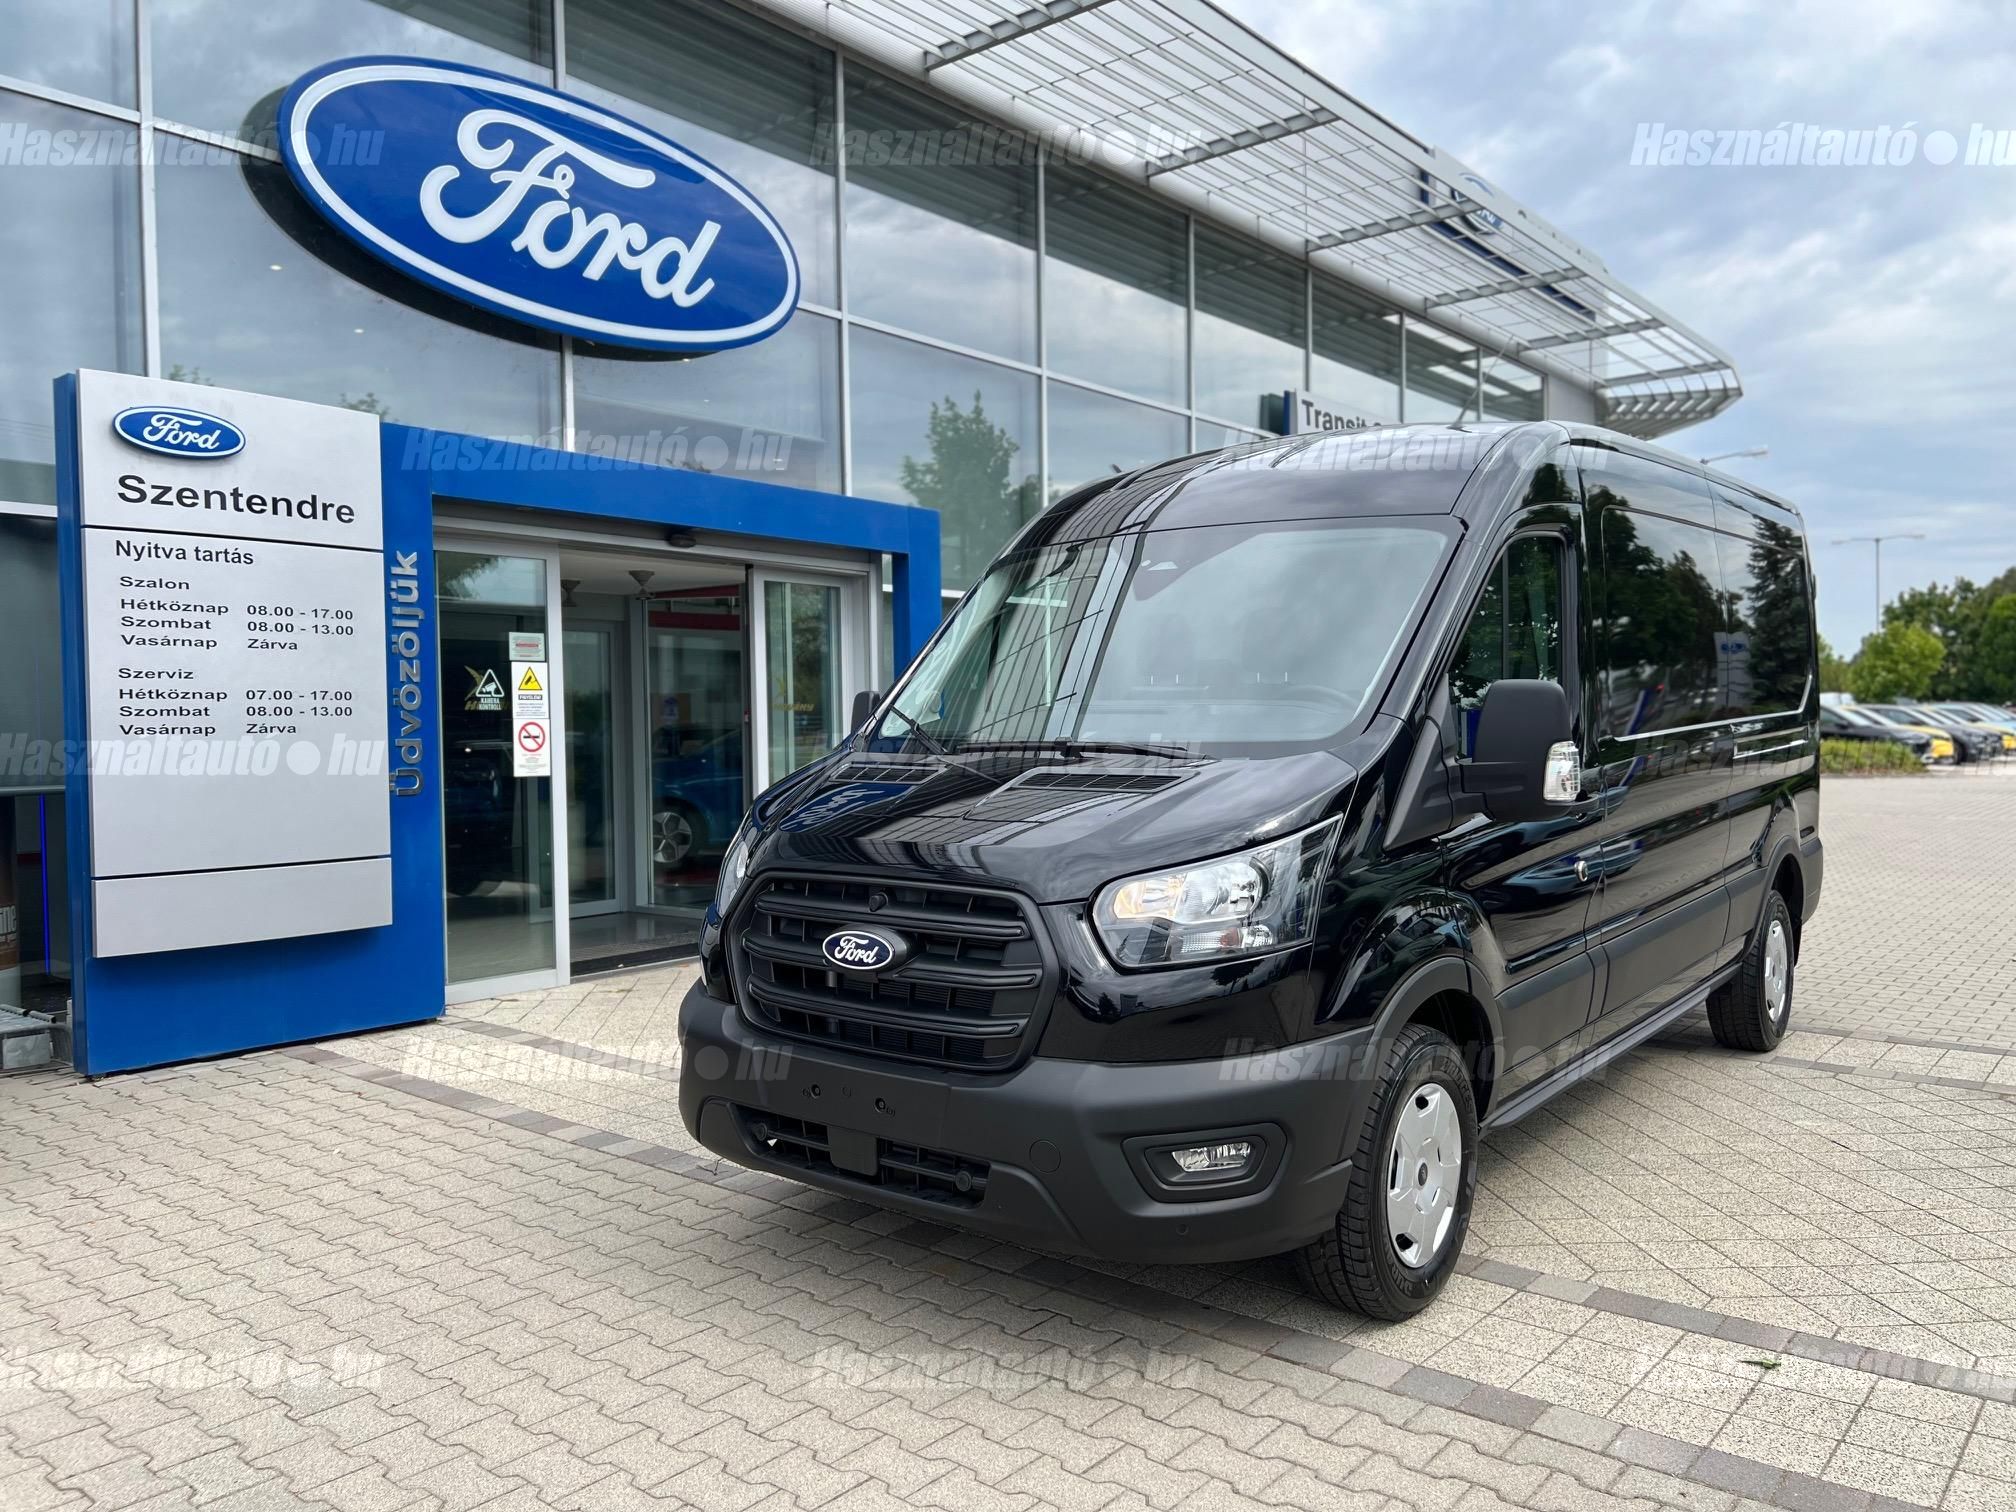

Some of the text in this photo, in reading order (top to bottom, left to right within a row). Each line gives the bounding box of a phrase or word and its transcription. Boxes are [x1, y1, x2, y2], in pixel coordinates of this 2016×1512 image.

[420, 109, 721, 307] Ford
[143, 413, 221, 450] Ford
[118, 474, 354, 523] Szentendre
[115, 540, 254, 565] Nyitva tartás
[120, 576, 190, 590] Szalon
[120, 598, 229, 615] Hétköznap
[246, 605, 294, 617] 08.00
[311, 608, 353, 620] 17.00
[120, 616, 211, 630] Szombat
[247, 621, 295, 633] 08.00
[311, 624, 354, 636] 13.00
[121, 634, 298, 650] Vasárnap Zárva
[118, 668, 194, 680] Szerviz
[389, 550, 424, 796] Üdvözöljük
[119, 688, 228, 702] Hétköznap
[245, 690, 293, 701] 07.00
[310, 690, 352, 701] 17.00
[119, 705, 210, 717] Szombat
[246, 706, 293, 717] 08.00
[310, 706, 353, 717] 13.00
[119, 723, 297, 737] Vasárnap Zárva
[834, 936, 879, 964] Ford
